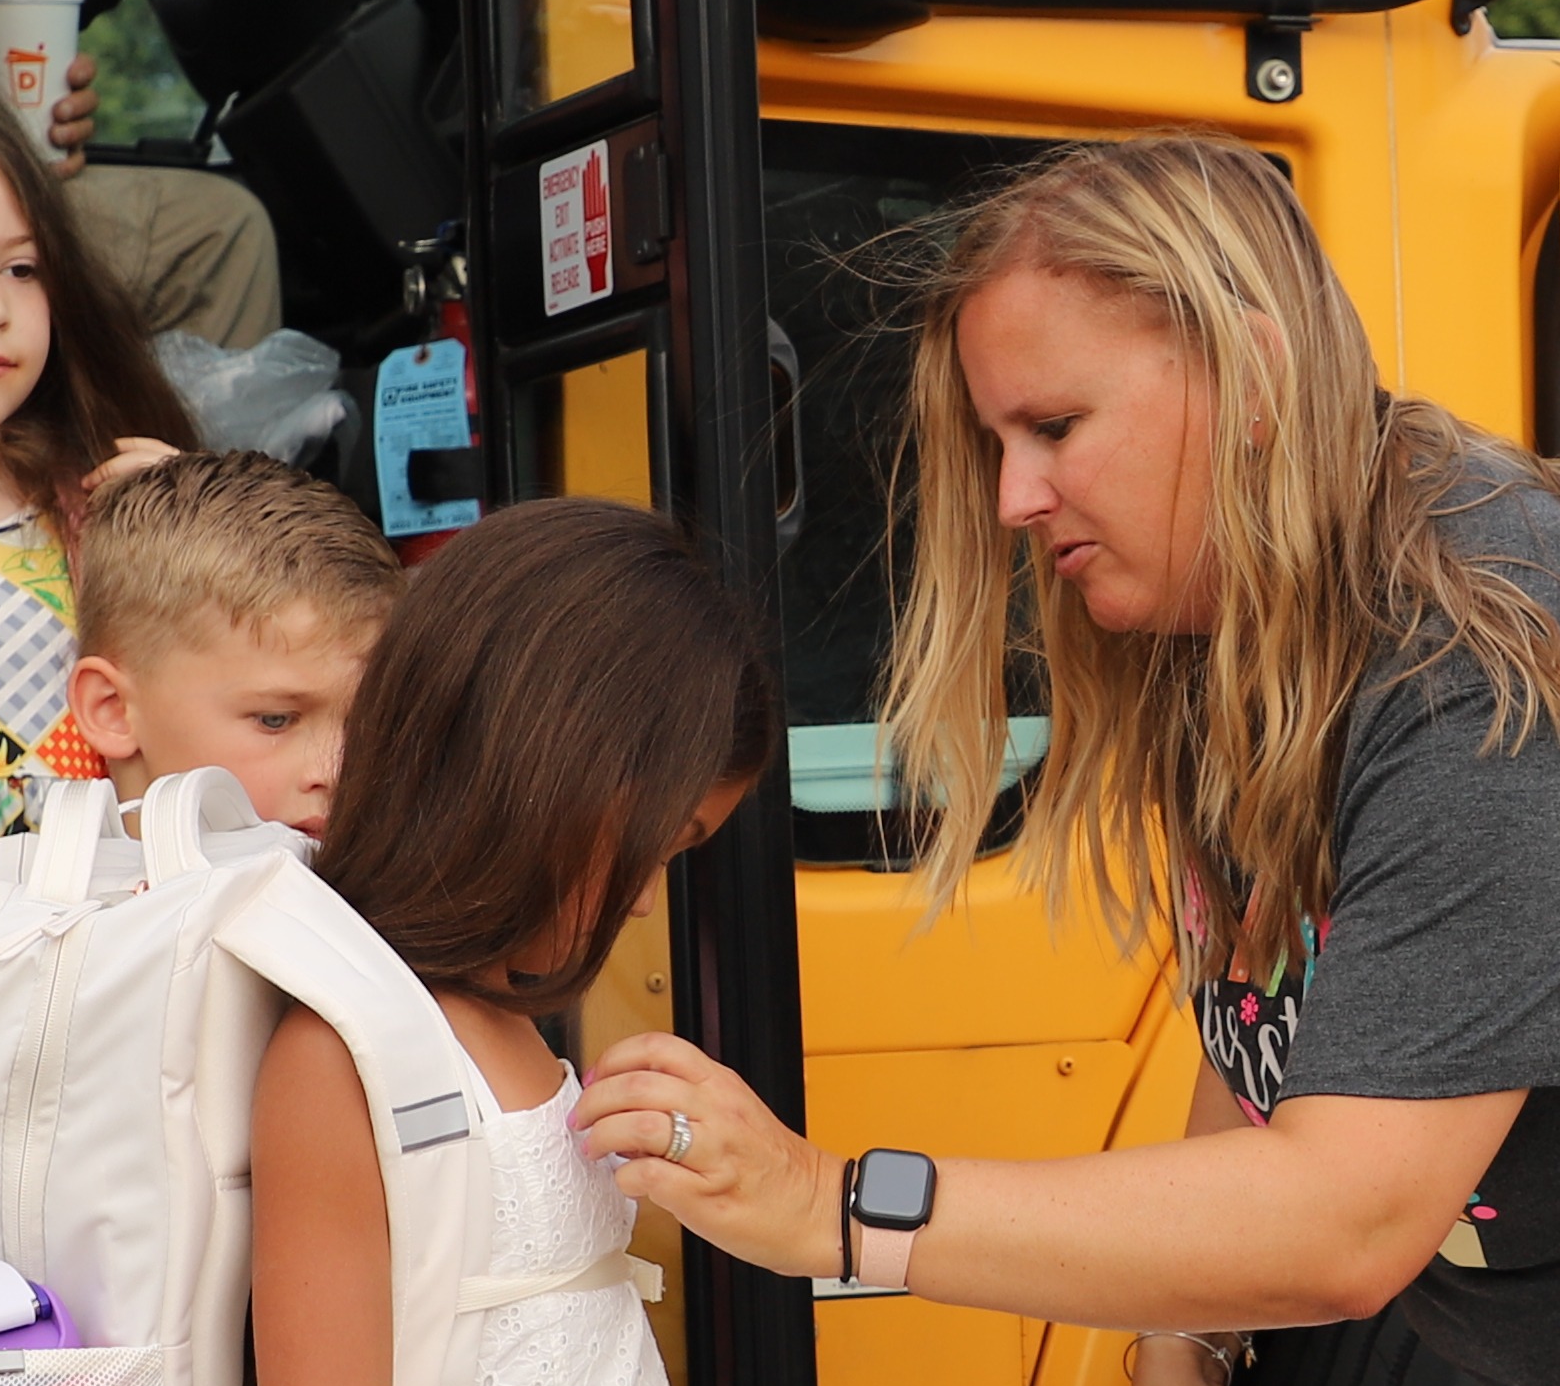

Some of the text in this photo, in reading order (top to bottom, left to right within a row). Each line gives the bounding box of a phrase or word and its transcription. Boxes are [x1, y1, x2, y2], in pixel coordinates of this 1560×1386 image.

[18, 72, 36, 90] D
[543, 165, 580, 200] EMERGENCY
[555, 201, 570, 229] EXIT
[585, 215, 607, 239] PUSH
[550, 231, 579, 263] ACTIVATE
[586, 233, 607, 258] HERE
[551, 265, 580, 295] RELEASE
